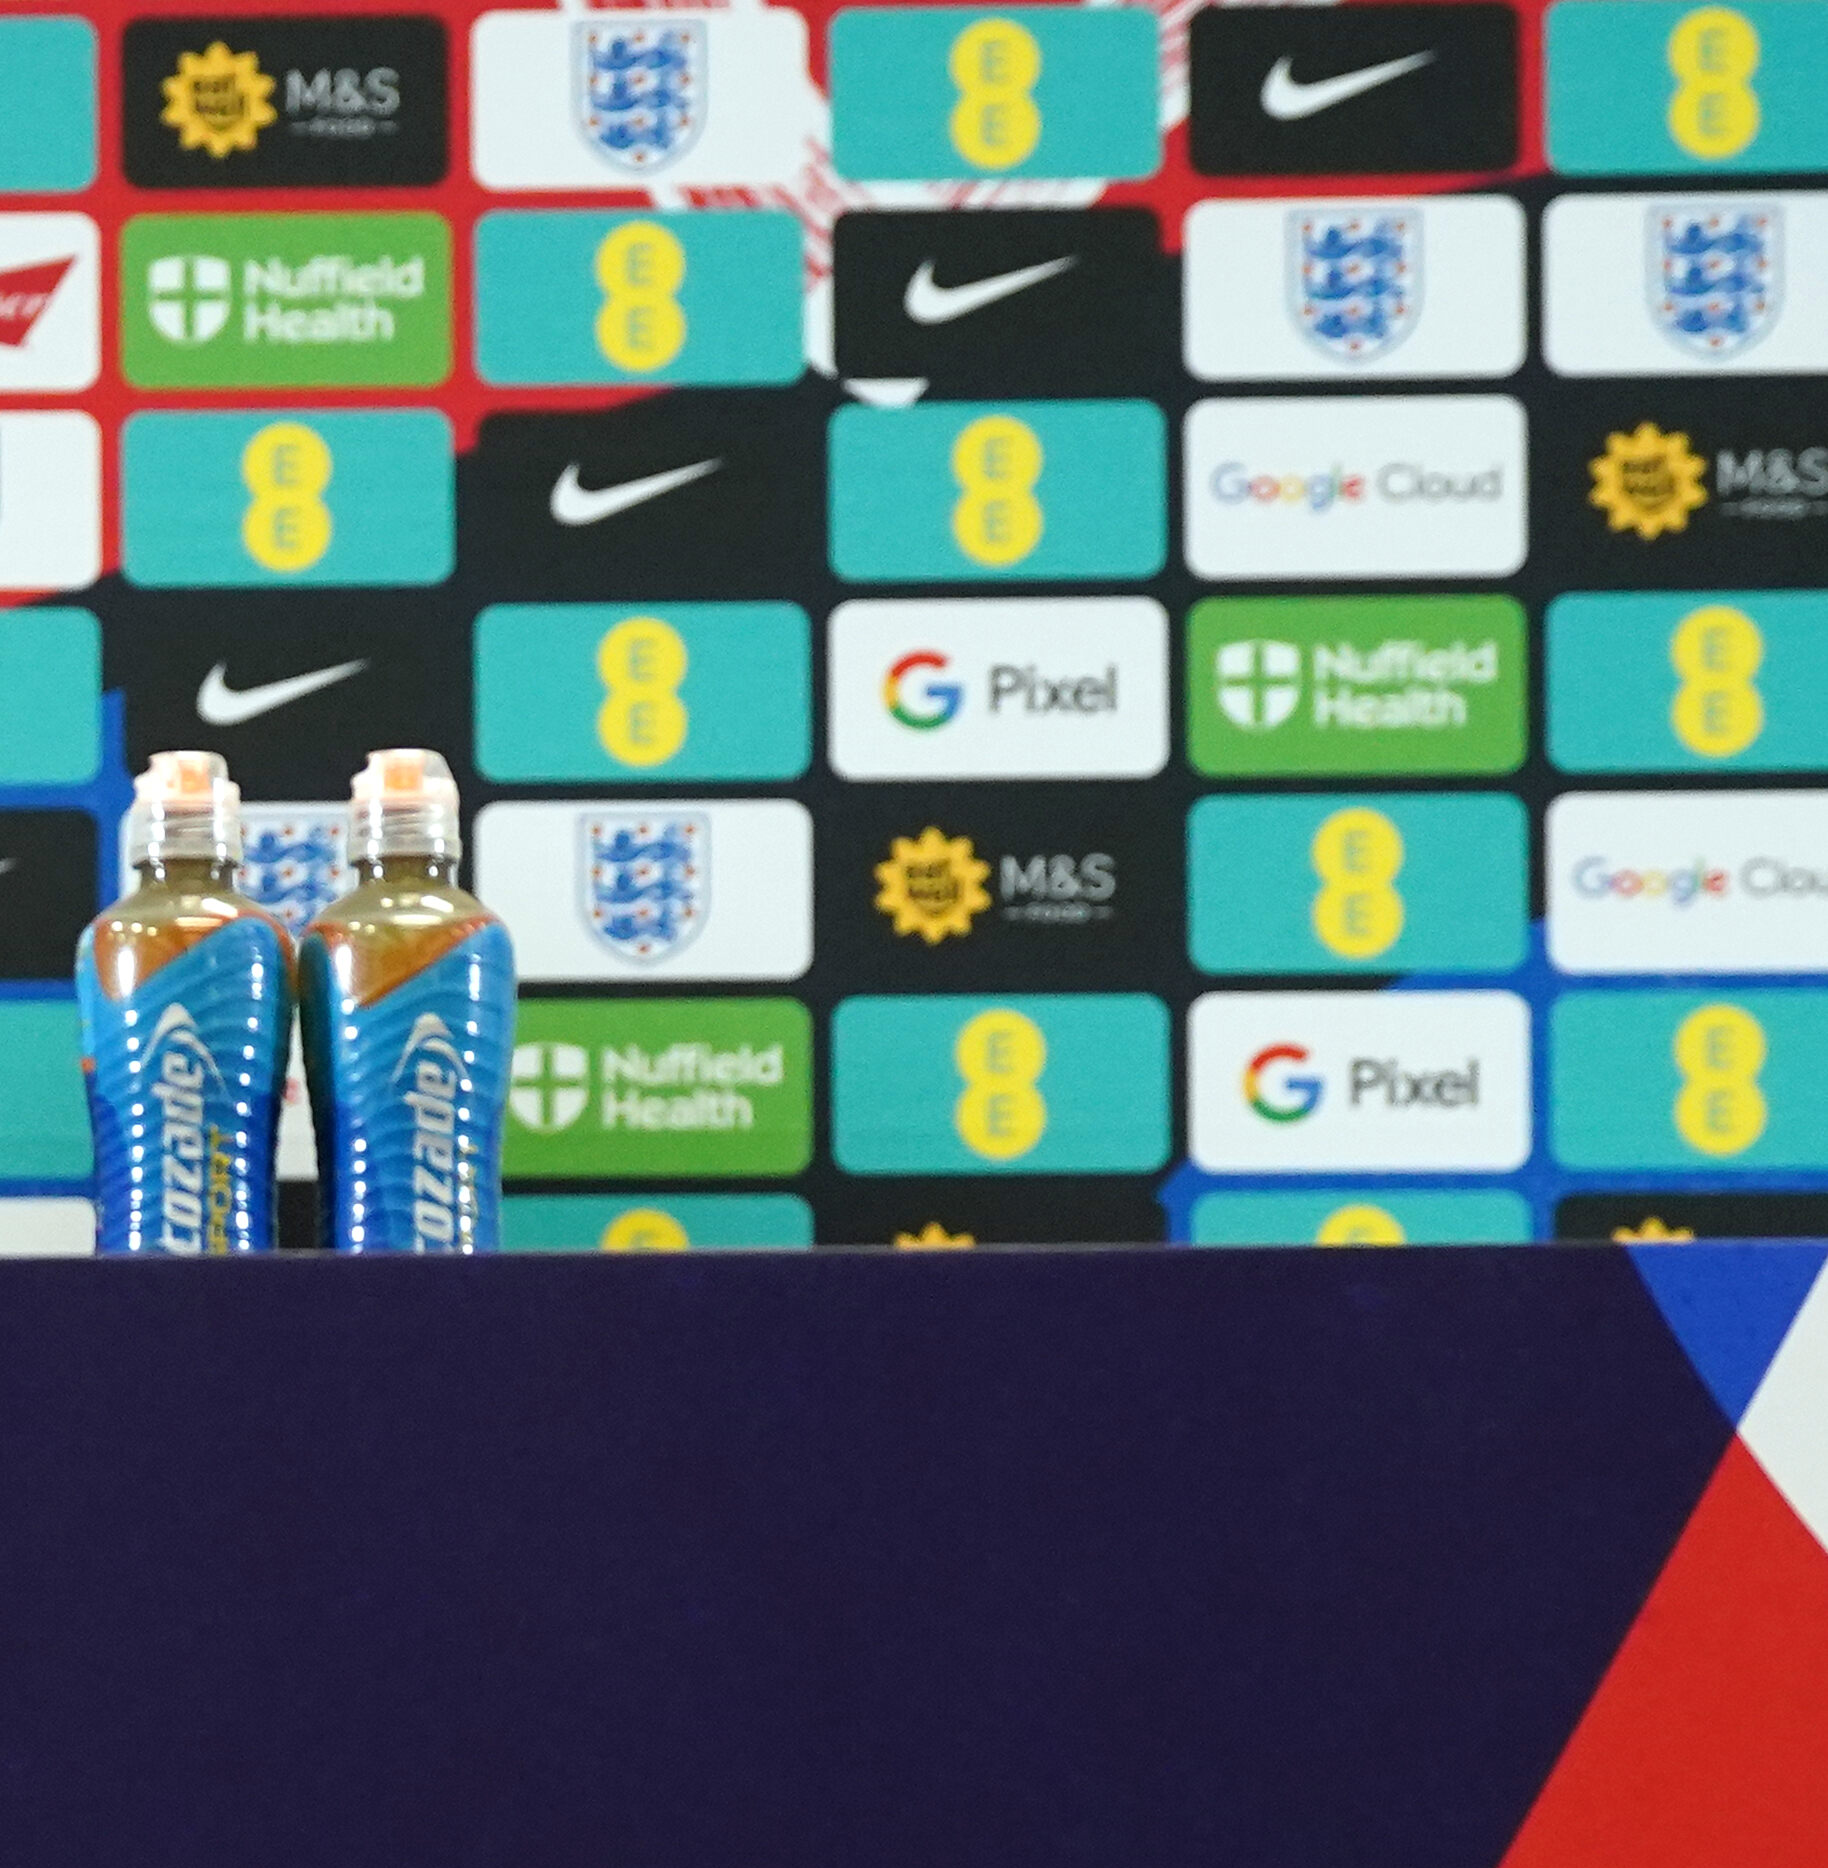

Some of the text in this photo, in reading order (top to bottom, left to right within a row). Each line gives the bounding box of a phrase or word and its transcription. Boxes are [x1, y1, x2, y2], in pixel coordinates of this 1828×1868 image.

[286, 68, 400, 114] M&S
[244, 255, 424, 301] Nuffield
[244, 301, 394, 343] Health
[1210, 462, 1504, 513] Google Cloud
[1717, 448, 1828, 495] M&S
[1313, 641, 1497, 686] Nuffield
[989, 665, 1117, 715] Pixel
[1313, 686, 1467, 729] Health
[1001, 853, 1115, 900] M&S
[1572, 856, 1730, 908] Google
[602, 1042, 783, 1088] Nuffield
[1349, 1058, 1479, 1108] Pixel
[602, 1088, 753, 1130] Health
[150, 1051, 203, 1254] cozade
[403, 1060, 457, 1253] ozade
